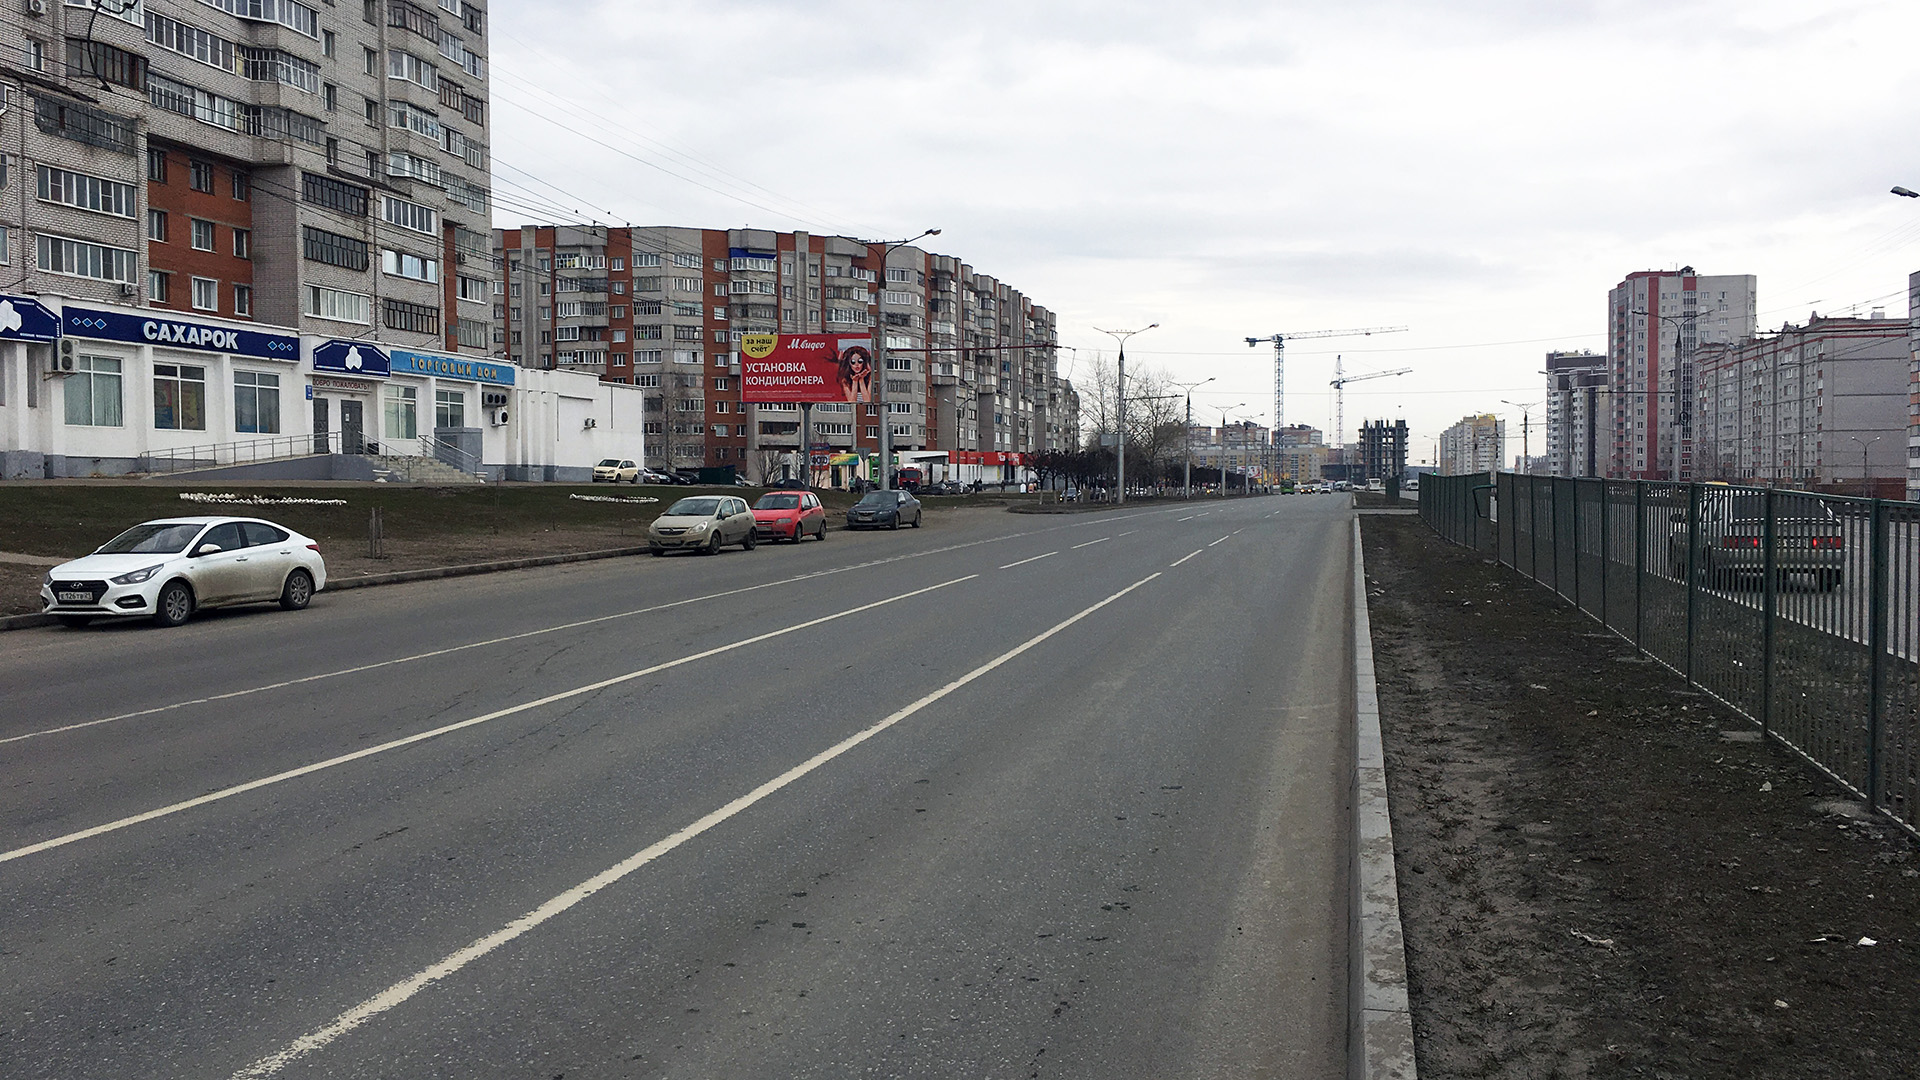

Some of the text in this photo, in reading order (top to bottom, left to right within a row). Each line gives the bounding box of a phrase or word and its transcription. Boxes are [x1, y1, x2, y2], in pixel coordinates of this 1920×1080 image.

[143, 321, 239, 350] САХАРОК
[410, 357, 497, 379] ТОРГОВЫЙ ДОМ
[746, 362, 807, 373] УСТАНОВКА
[312, 378, 331, 387] ДОБРО
[745, 375, 825, 387] КОНДИЦИОНЕРА
